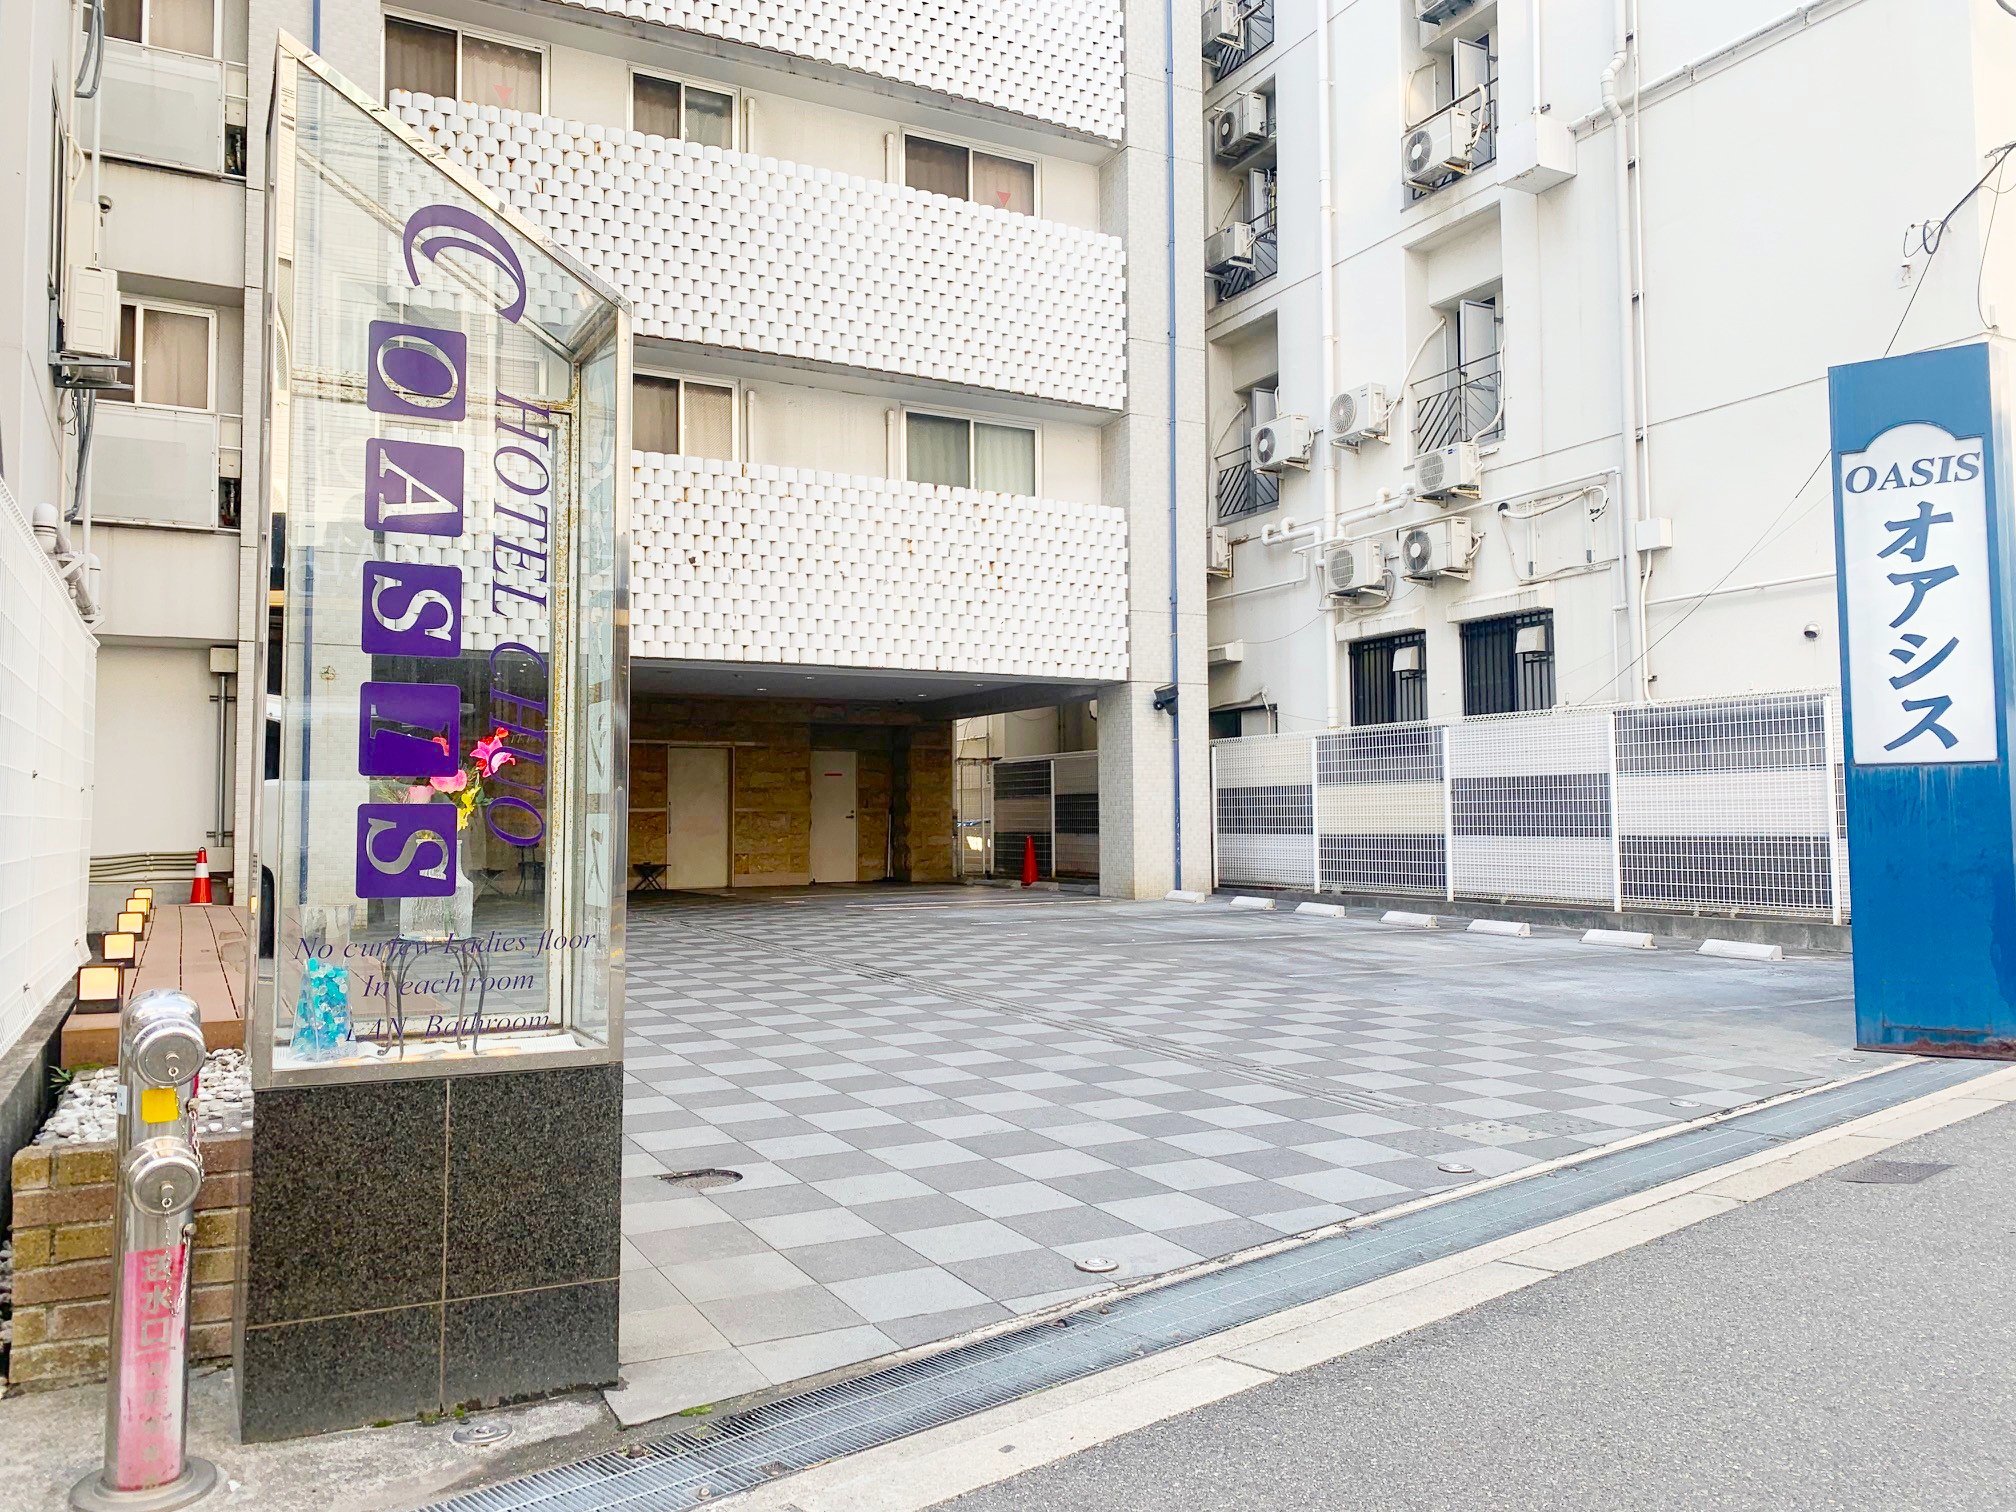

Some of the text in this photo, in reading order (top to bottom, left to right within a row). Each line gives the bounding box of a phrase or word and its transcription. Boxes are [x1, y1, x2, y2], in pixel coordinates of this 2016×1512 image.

[1844, 451, 1982, 494] OASIS
[365, 333, 460, 881] OASIS
[486, 386, 551, 847] HOTEL CHUO
[1876, 500, 1960, 752] オアシス
[293, 929, 596, 961] No curfew Ladies floor
[362, 971, 534, 997] In each room
[345, 1012, 550, 1042] LAN Bathroom
[140, 1253, 172, 1347] 送水口
